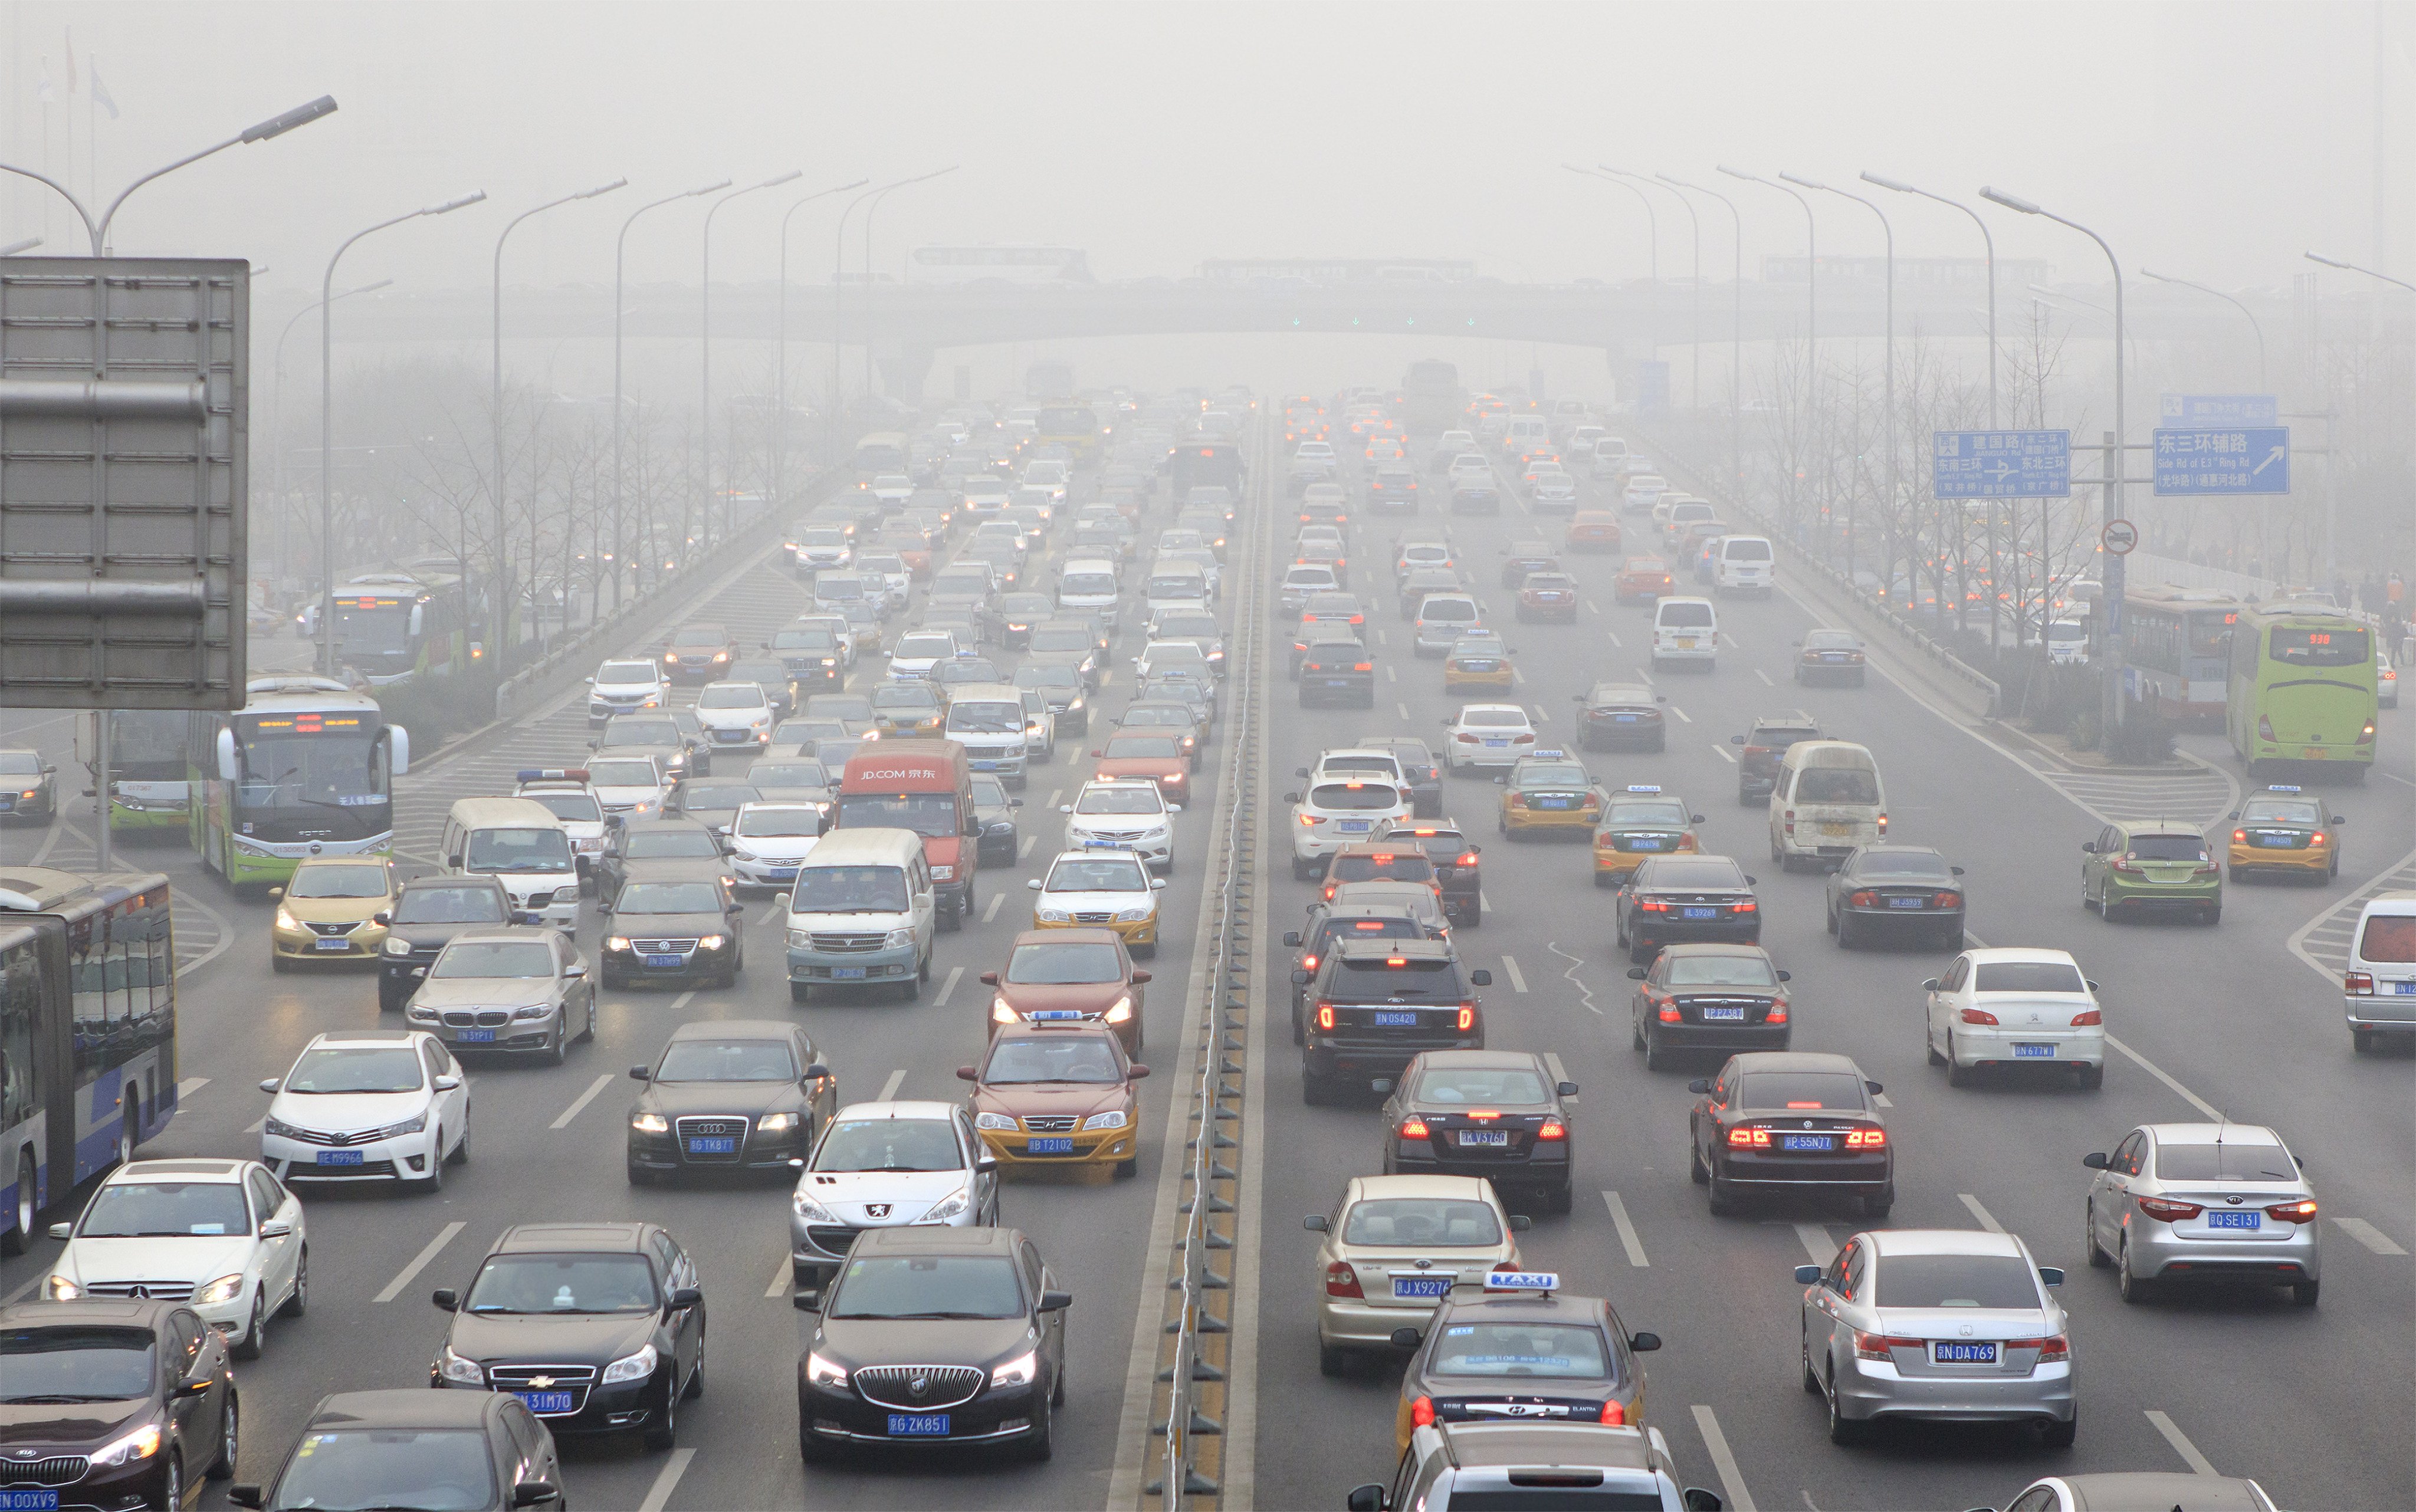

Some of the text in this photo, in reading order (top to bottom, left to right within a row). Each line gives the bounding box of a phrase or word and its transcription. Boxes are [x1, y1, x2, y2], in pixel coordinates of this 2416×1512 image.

[1972, 435, 2020, 449] 建国路
[2159, 433, 2247, 453] 东三环辅路
[1938, 458, 1982, 472] 东南三环
[2022, 456, 2066, 471] 东北三环
[2158, 458, 2174, 468] Side
[2177, 458, 2187, 468] Rd
[2190, 458, 2198, 468] of
[2220, 457, 2236, 469] Ring
[2240, 456, 2250, 467] Rd
[861, 769, 935, 780] JD.COM 京东
[1496, 1274, 1550, 1284] TAXI
